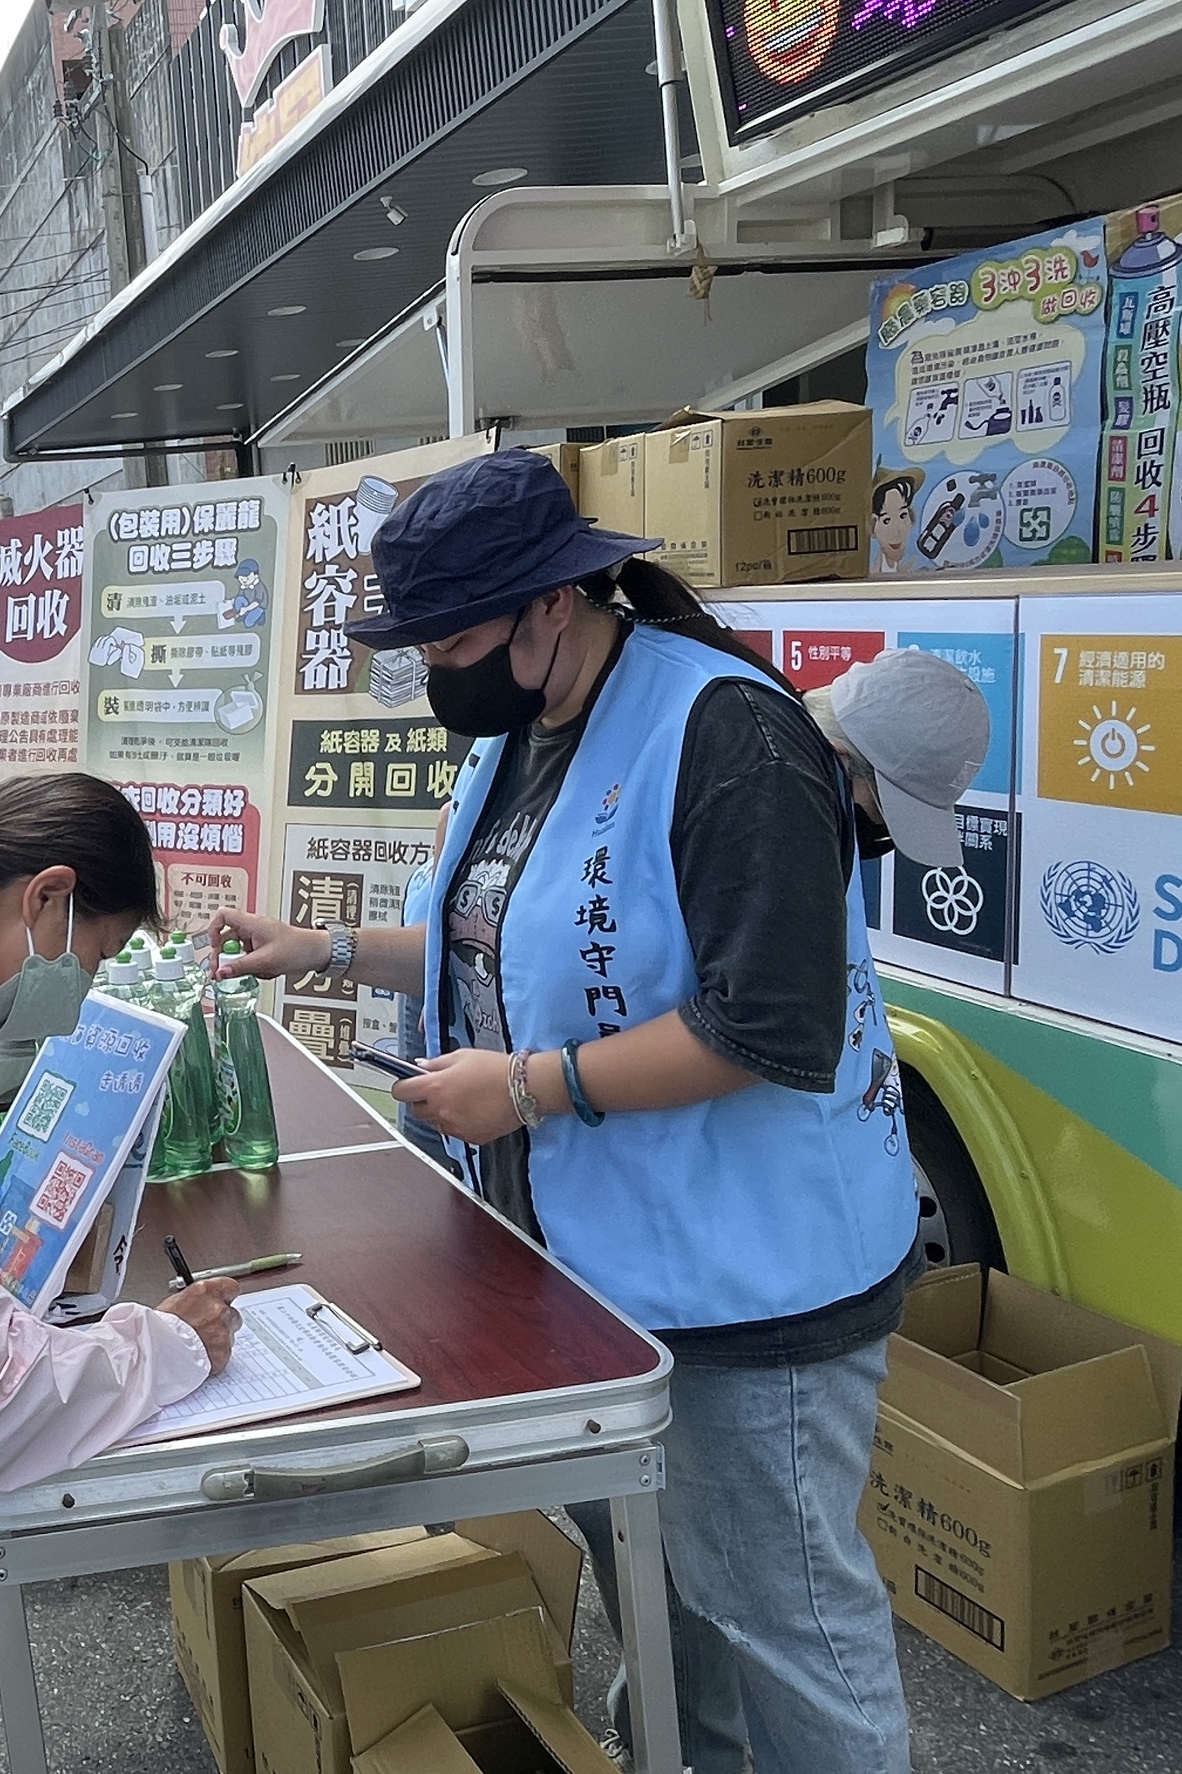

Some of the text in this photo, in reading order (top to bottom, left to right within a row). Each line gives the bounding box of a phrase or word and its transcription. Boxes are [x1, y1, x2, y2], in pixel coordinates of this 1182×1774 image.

[980, 256, 1070, 304] 3沖3洗
[1039, 288, 1099, 318] 做回收
[1140, 284, 1177, 417] 高壓空瓶
[747, 466, 847, 489] 洗潔精600g
[108, 500, 261, 542] (包裝用)保麗龍
[127, 536, 238, 574] 回收三步驟
[298, 497, 359, 692] 紙容器
[4, 588, 70, 644] 回收
[790, 640, 803, 671] 5
[807, 645, 853, 662] 性別平等
[1053, 647, 1068, 685] 7
[1078, 650, 1166, 671] 經濟適用的
[1078, 668, 1147, 689] 清潔能源
[104, 696, 120, 716] 裝
[303, 760, 461, 800] 分開回收
[116, 784, 246, 817] 衣回收分類好
[306, 836, 436, 866] 紙容器回收方
[180, 871, 233, 889] 不可回收
